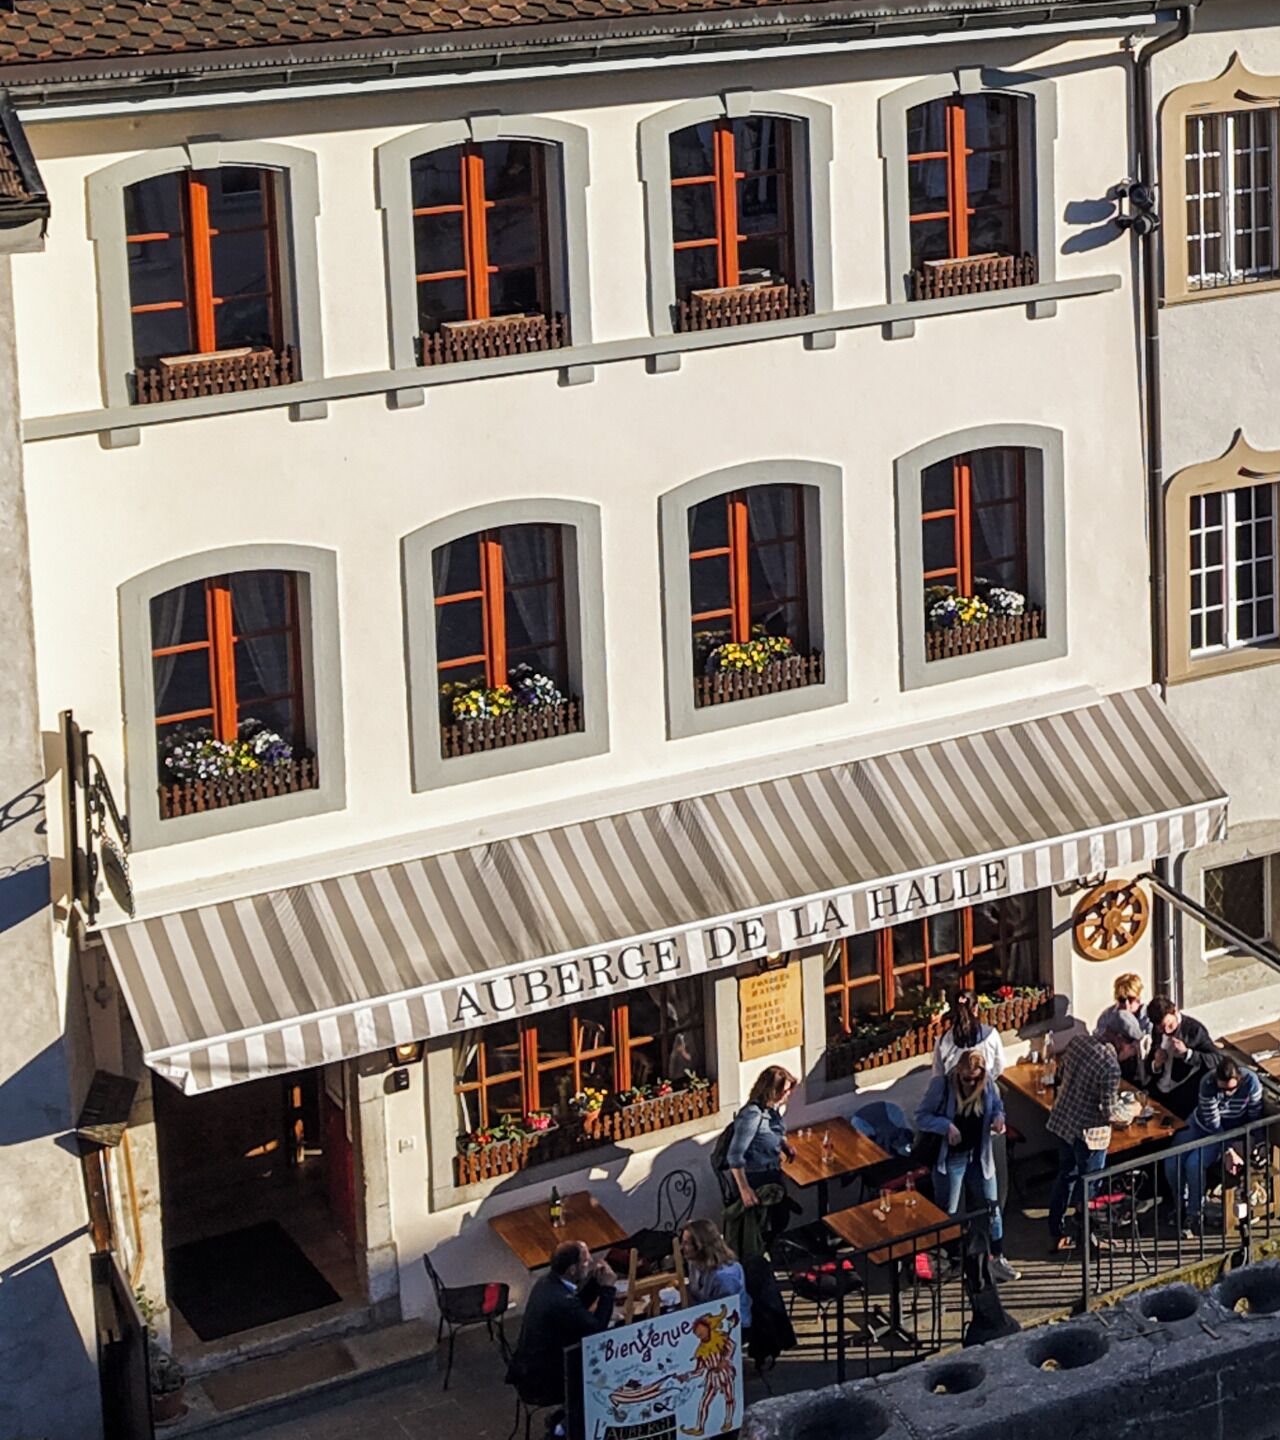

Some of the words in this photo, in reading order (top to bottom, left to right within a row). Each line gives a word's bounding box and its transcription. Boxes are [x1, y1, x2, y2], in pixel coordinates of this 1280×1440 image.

[452, 936, 682, 1023] AUBERGE
[707, 916, 768, 961] DE
[792, 899, 849, 940] LA
[868, 858, 1008, 921] HALLE
